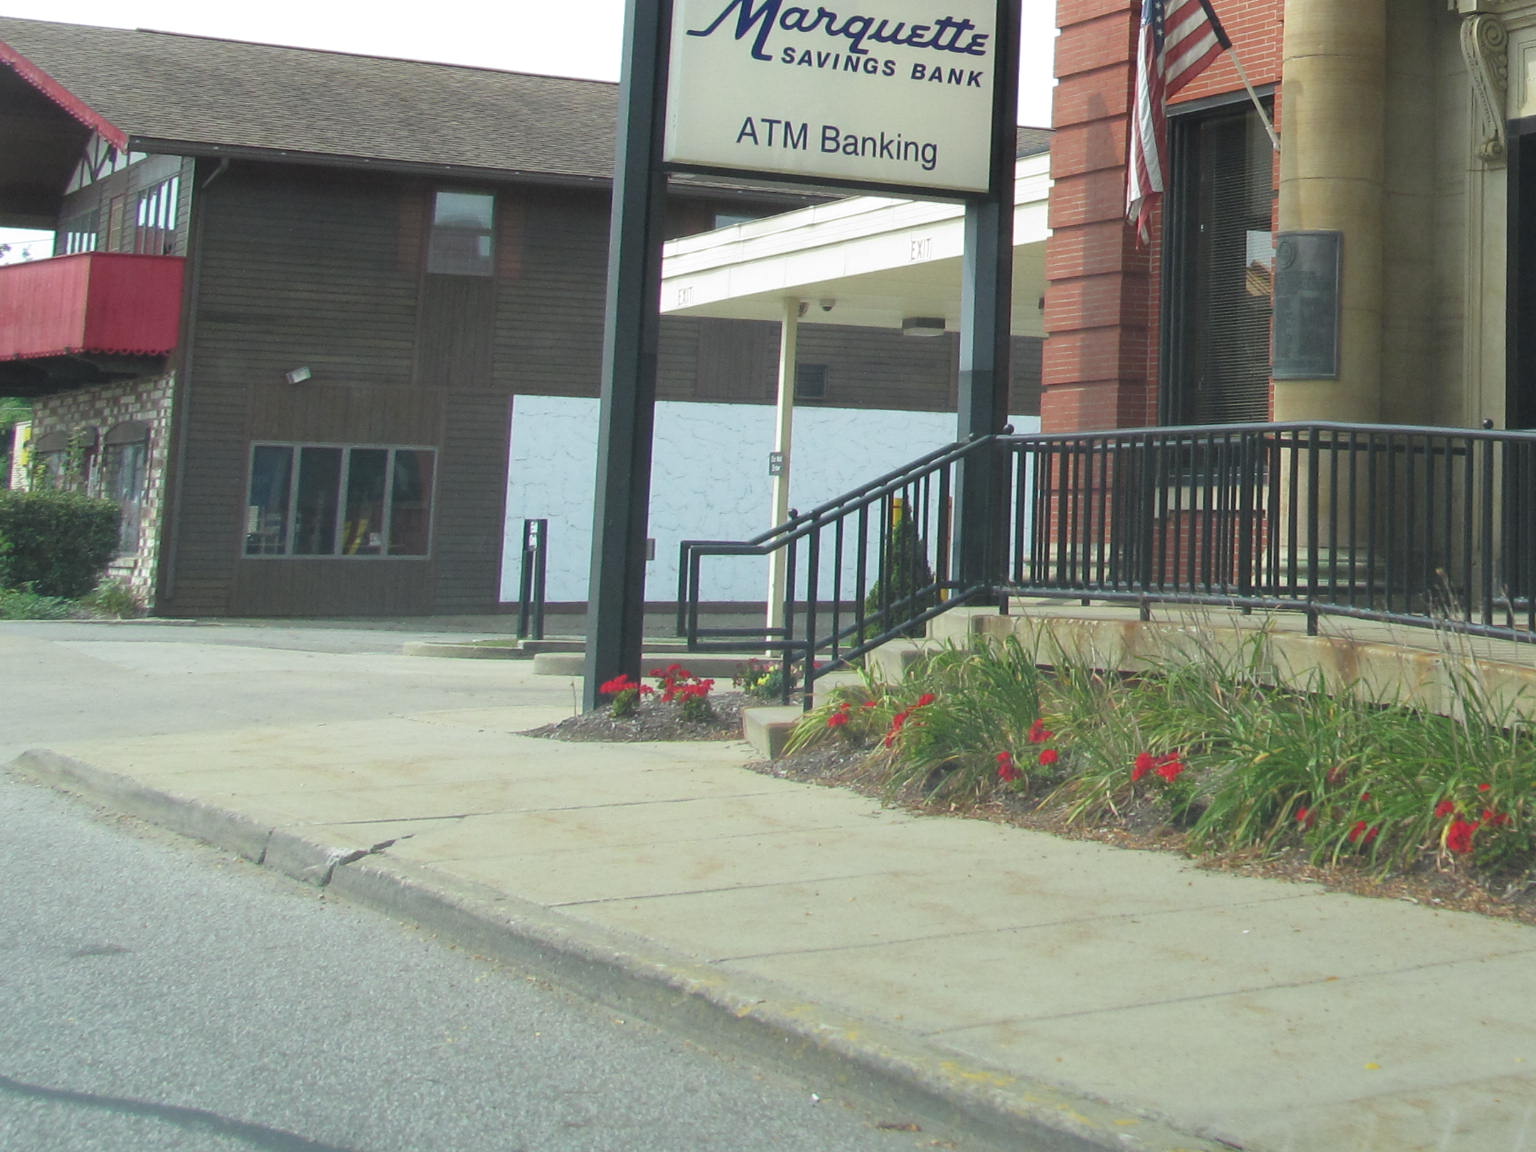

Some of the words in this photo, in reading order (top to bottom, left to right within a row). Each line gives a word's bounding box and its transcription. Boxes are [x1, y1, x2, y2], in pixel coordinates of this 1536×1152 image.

[780, 46, 897, 77] SAVINGS
[910, 62, 985, 88] BANK
[735, 115, 809, 151] ATM
[820, 124, 939, 171] Banking
[910, 237, 932, 261] EXIT
